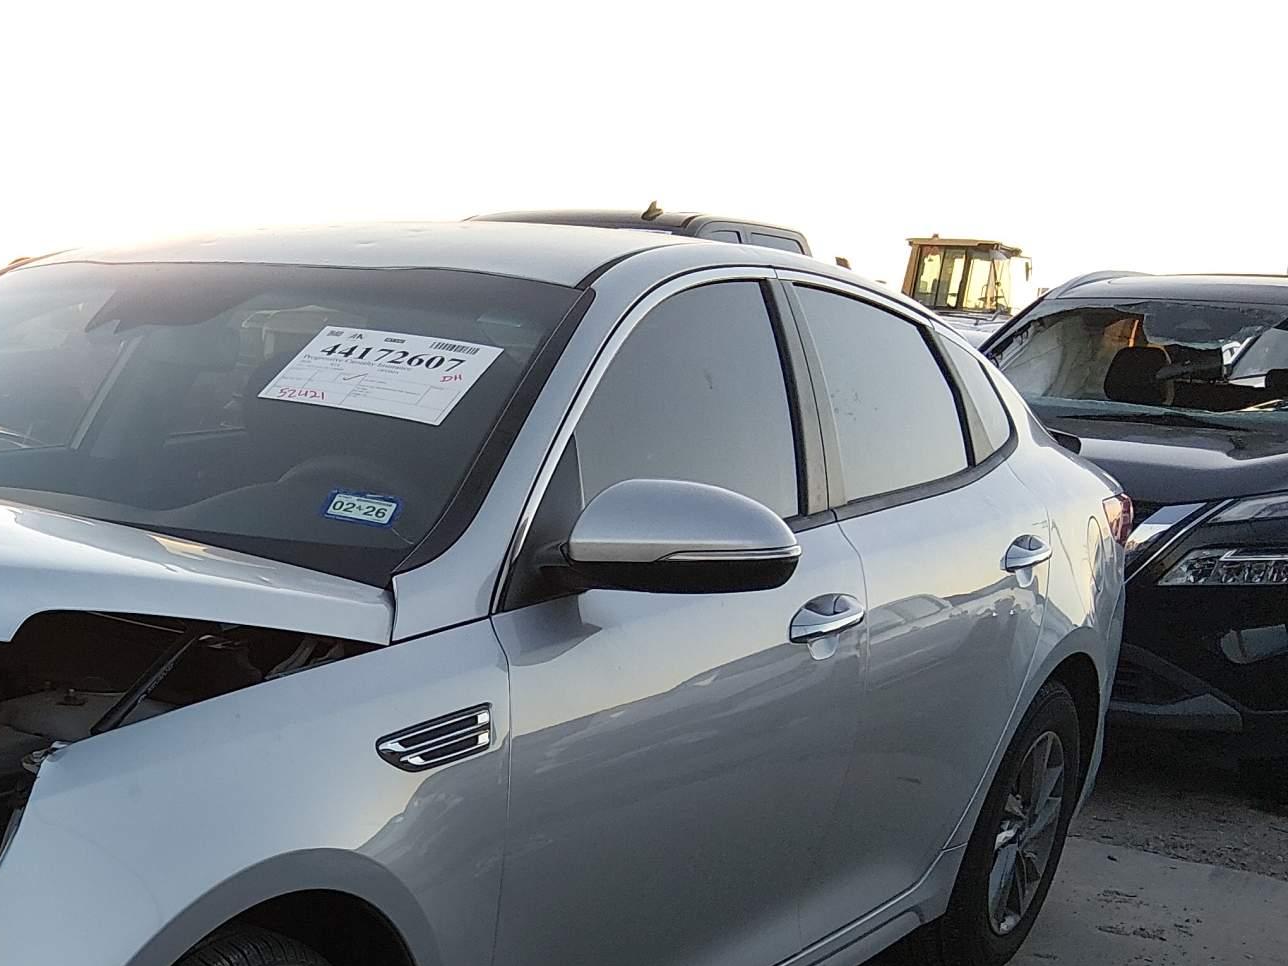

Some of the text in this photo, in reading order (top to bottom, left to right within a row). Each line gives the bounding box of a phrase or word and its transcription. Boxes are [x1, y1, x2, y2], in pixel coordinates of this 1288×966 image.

[319, 343, 466, 373] 44172607
[332, 500, 356, 513] 02
[362, 505, 388, 519] 26
